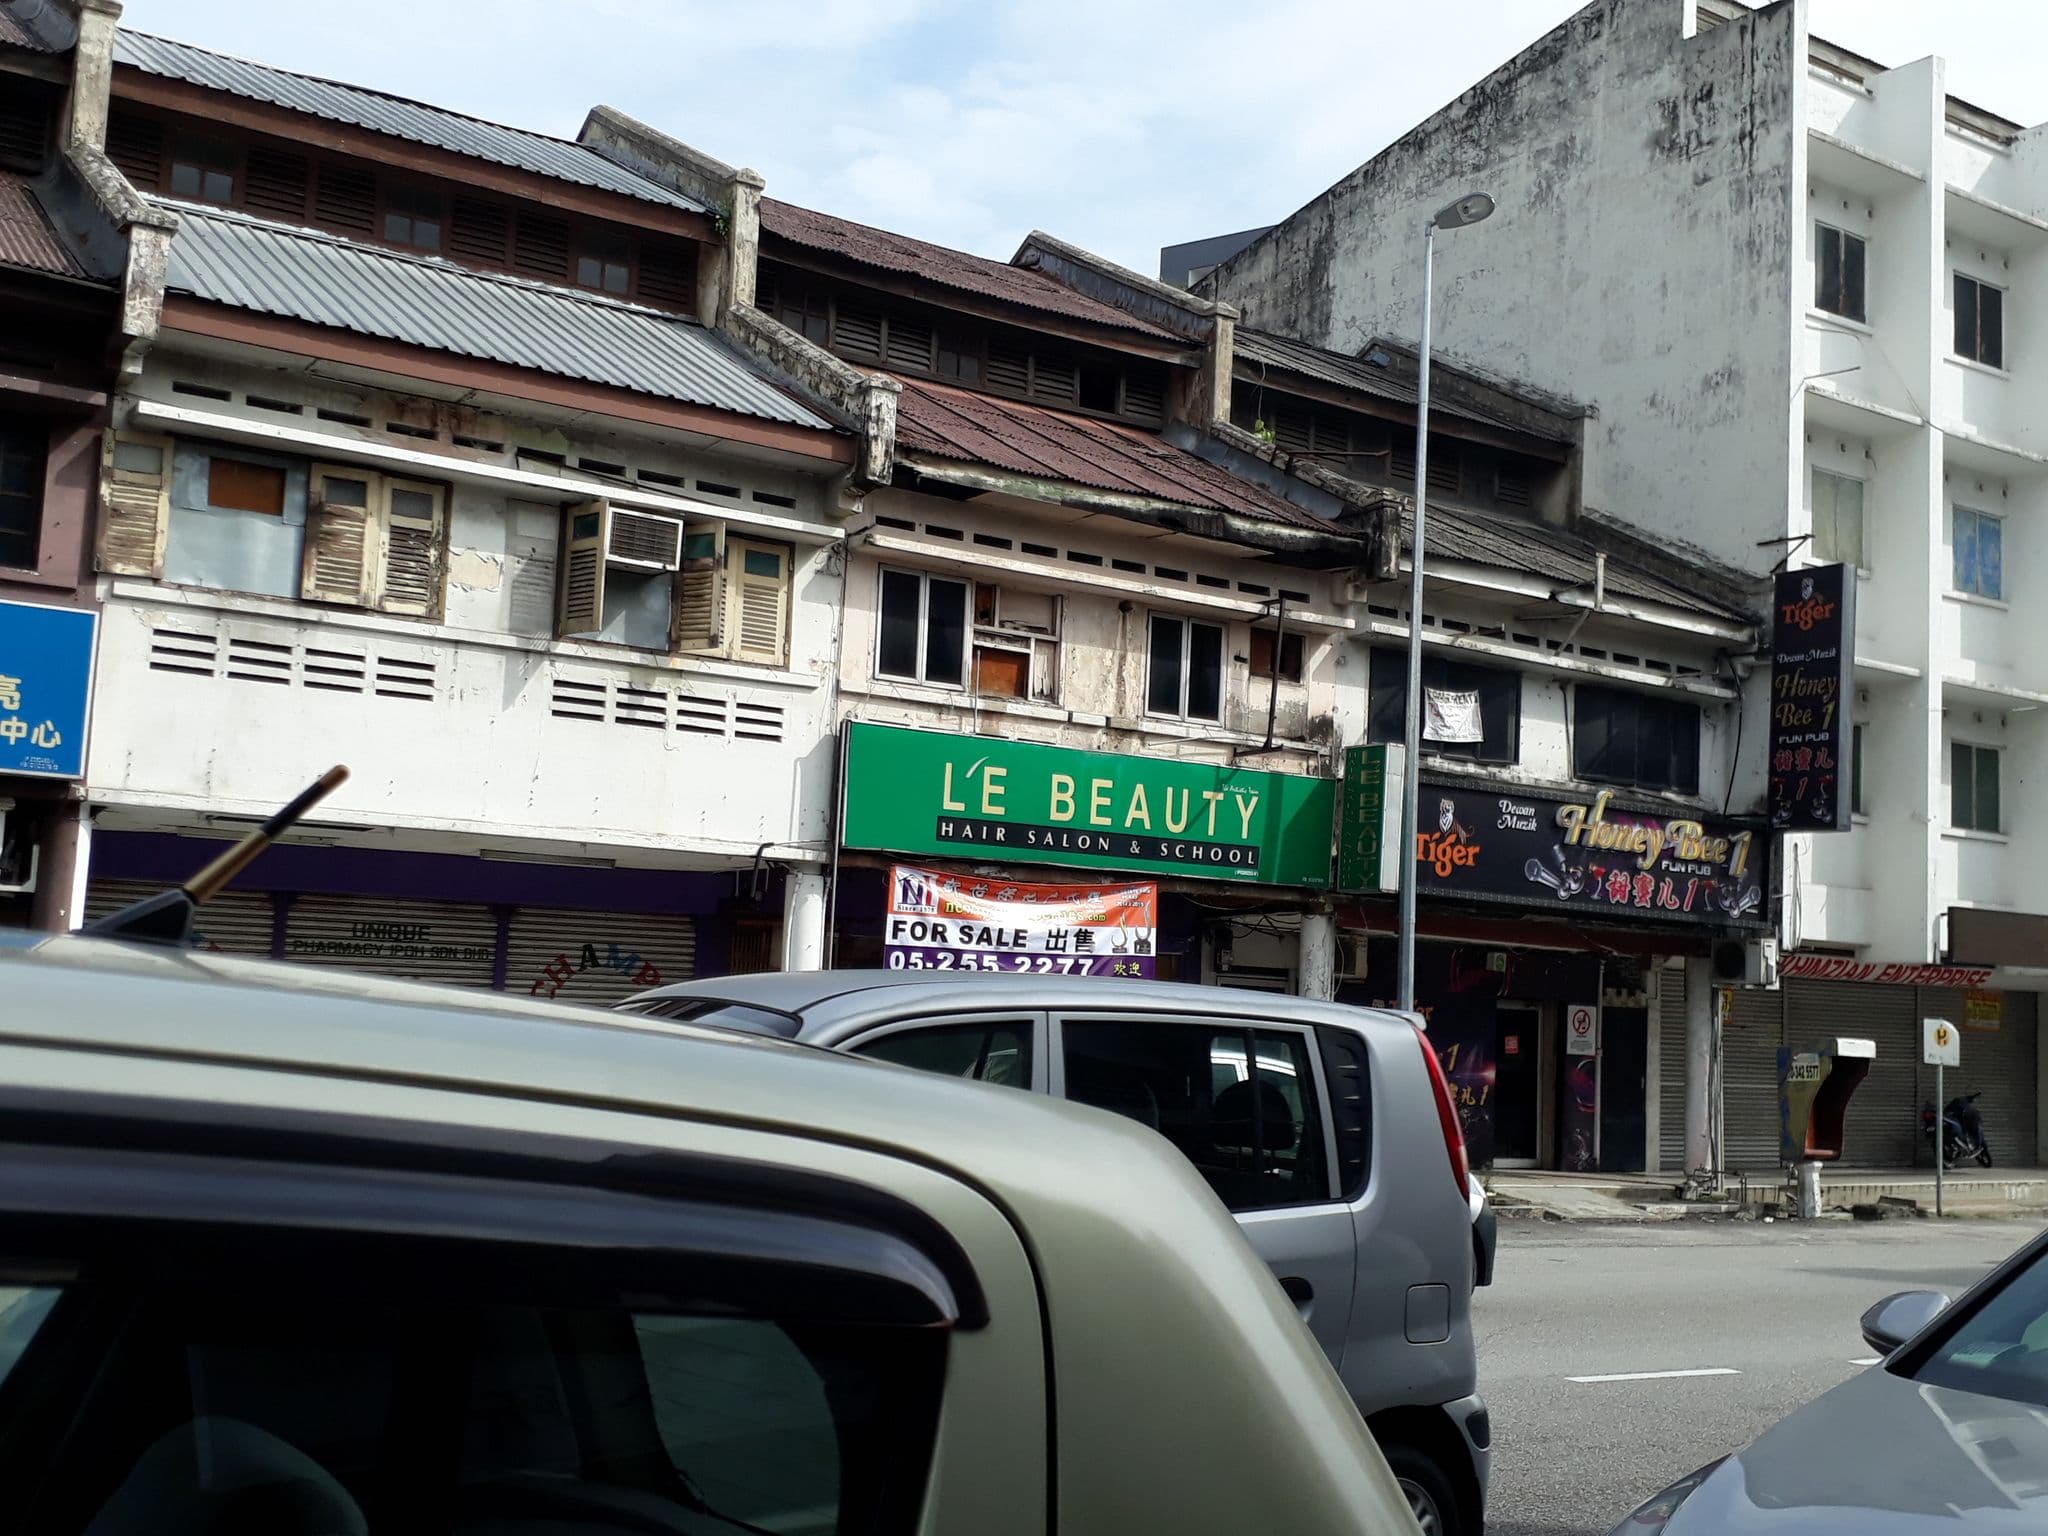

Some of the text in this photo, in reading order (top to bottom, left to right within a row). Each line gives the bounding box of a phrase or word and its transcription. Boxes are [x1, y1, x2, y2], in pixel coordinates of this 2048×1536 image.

[1782, 600, 1834, 630] Tiger
[1775, 667, 1837, 703] Honey
[1775, 701, 1835, 730] Bee 1
[0, 716, 61, 748] 中心
[1050, 773, 1259, 839] BEAUTY
[1499, 800, 1535, 816] Dewan
[1497, 816, 1537, 831] Muzik
[1556, 790, 1752, 878] Honey Bee 1
[941, 822, 1255, 865] HAIR SALON & SCHOOL
[1416, 832, 1480, 877] Tiger
[1662, 860, 1711, 876] FUN PUB
[353, 922, 431, 941] UNIQUE
[892, 920, 1029, 949] FOR SALE
[1045, 928, 1096, 953] 出售
[889, 951, 1094, 976] 05-255 2277
